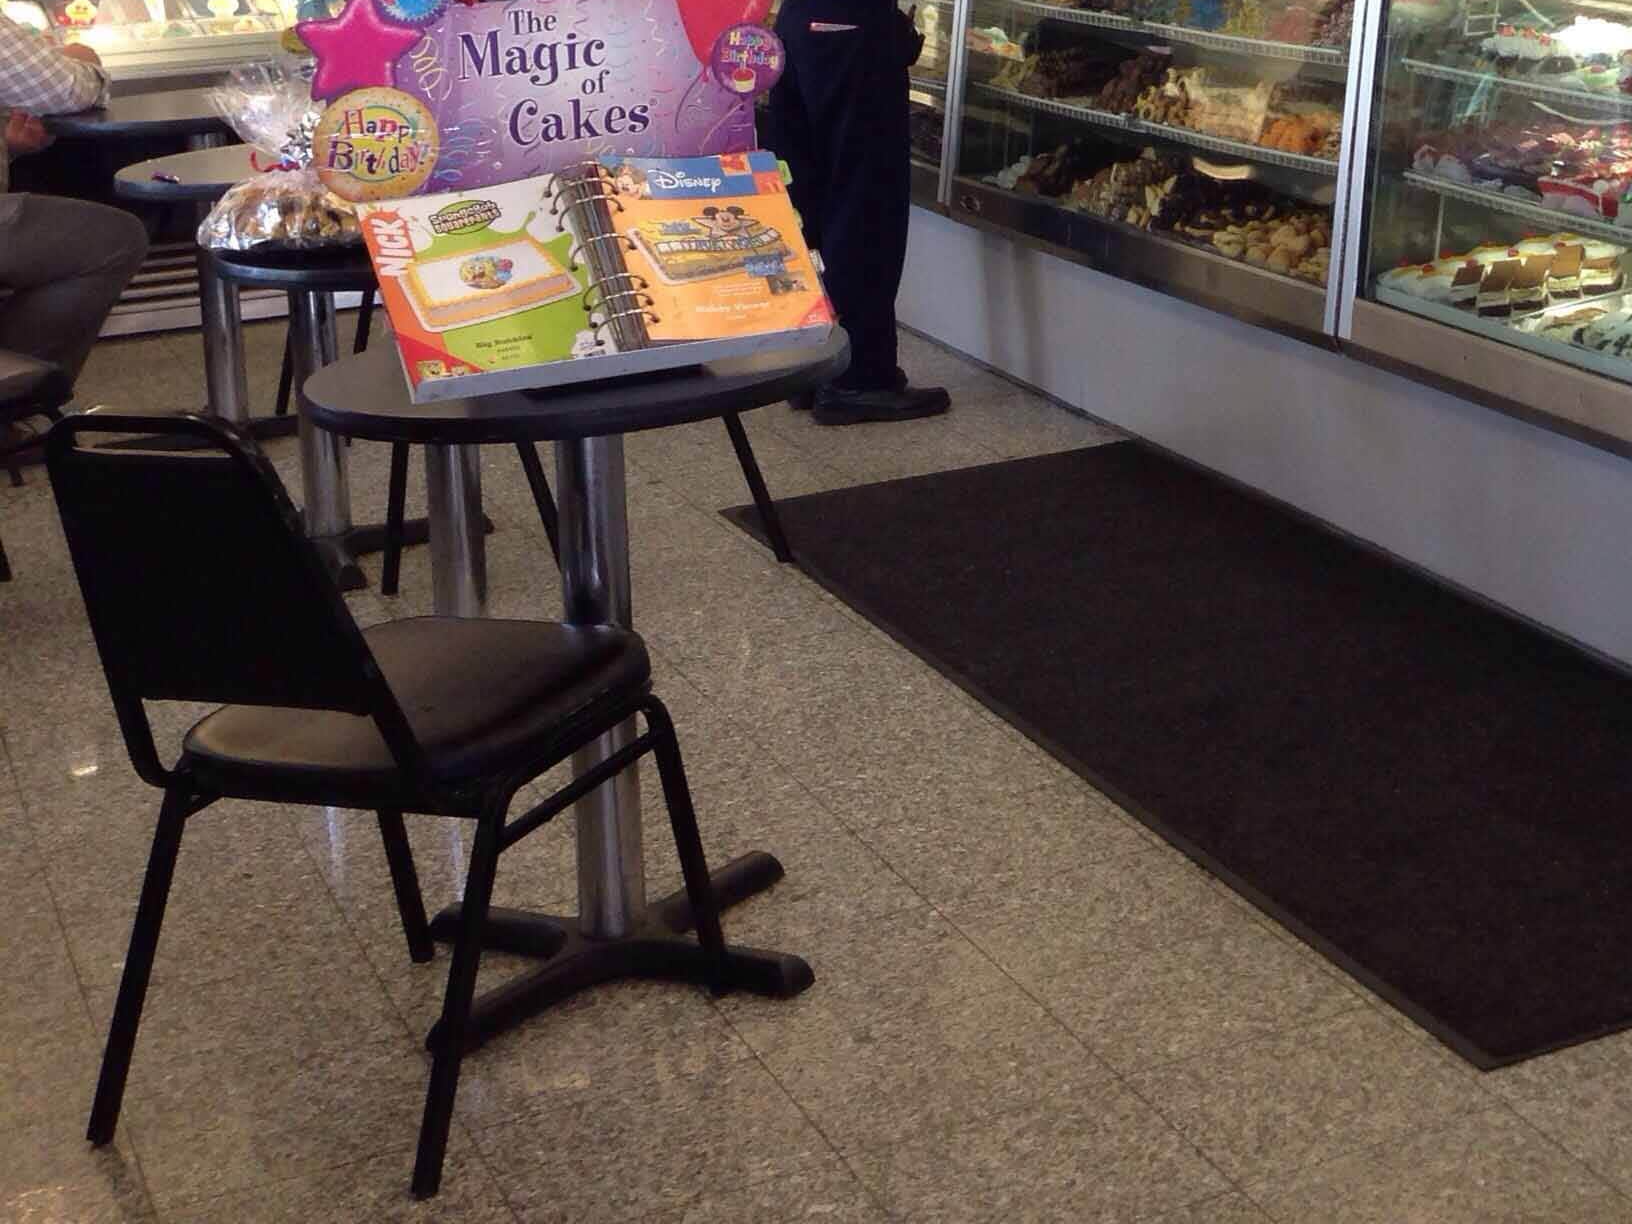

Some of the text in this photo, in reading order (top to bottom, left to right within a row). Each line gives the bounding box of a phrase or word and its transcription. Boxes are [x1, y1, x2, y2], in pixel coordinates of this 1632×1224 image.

[508, 8, 557, 36] The
[457, 28, 606, 86] Magic
[581, 70, 610, 95] of
[509, 98, 650, 146] Cakes
[648, 169, 722, 192] Disney
[369, 217, 410, 277] NICK
